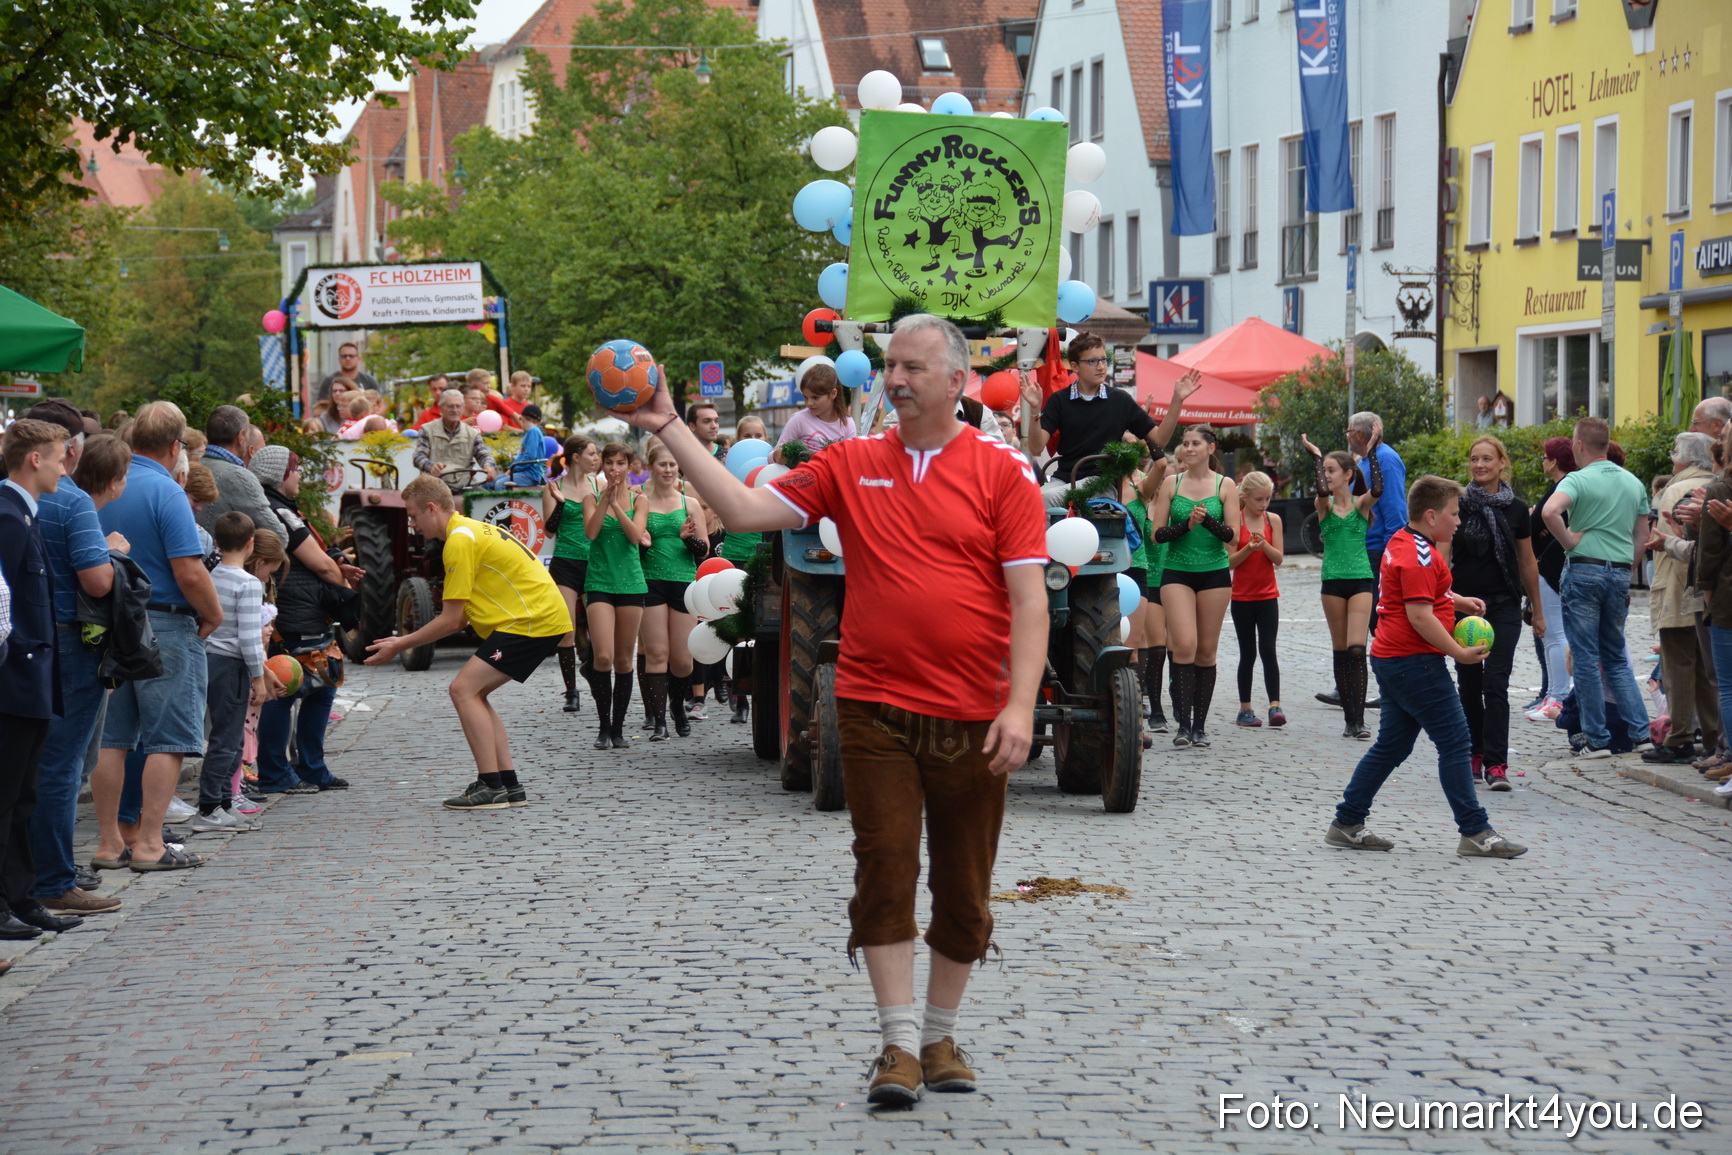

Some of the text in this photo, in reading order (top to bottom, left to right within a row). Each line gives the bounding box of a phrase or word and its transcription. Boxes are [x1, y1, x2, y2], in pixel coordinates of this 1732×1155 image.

[1299, 0, 1329, 76] K&L
[1328, 0, 1339, 74] RUPPER
[1532, 62, 1641, 119] HOTEL Lehmeier
[1605, 199, 1613, 243] P
[370, 268, 471, 285] FC HOLZHEIM
[1582, 265, 1638, 275] TAUN
[1671, 240, 1681, 285] P
[371, 293, 478, 305] Fußball, Tennis, Gymnastik,
[941, 292, 970, 311] DJK
[978, 261, 1026, 301] Neumarkt
[1524, 285, 1587, 316] Restaurant
[372, 309, 392, 317] Kraft
[400, 308, 431, 317] Fitness,
[433, 306, 475, 315] Kindertanz
[1156, 285, 1199, 324] K&L
[703, 386, 722, 394] TAXI
[1180, 409, 1226, 419] Restaurant
[859, 476, 894, 488] hummel
